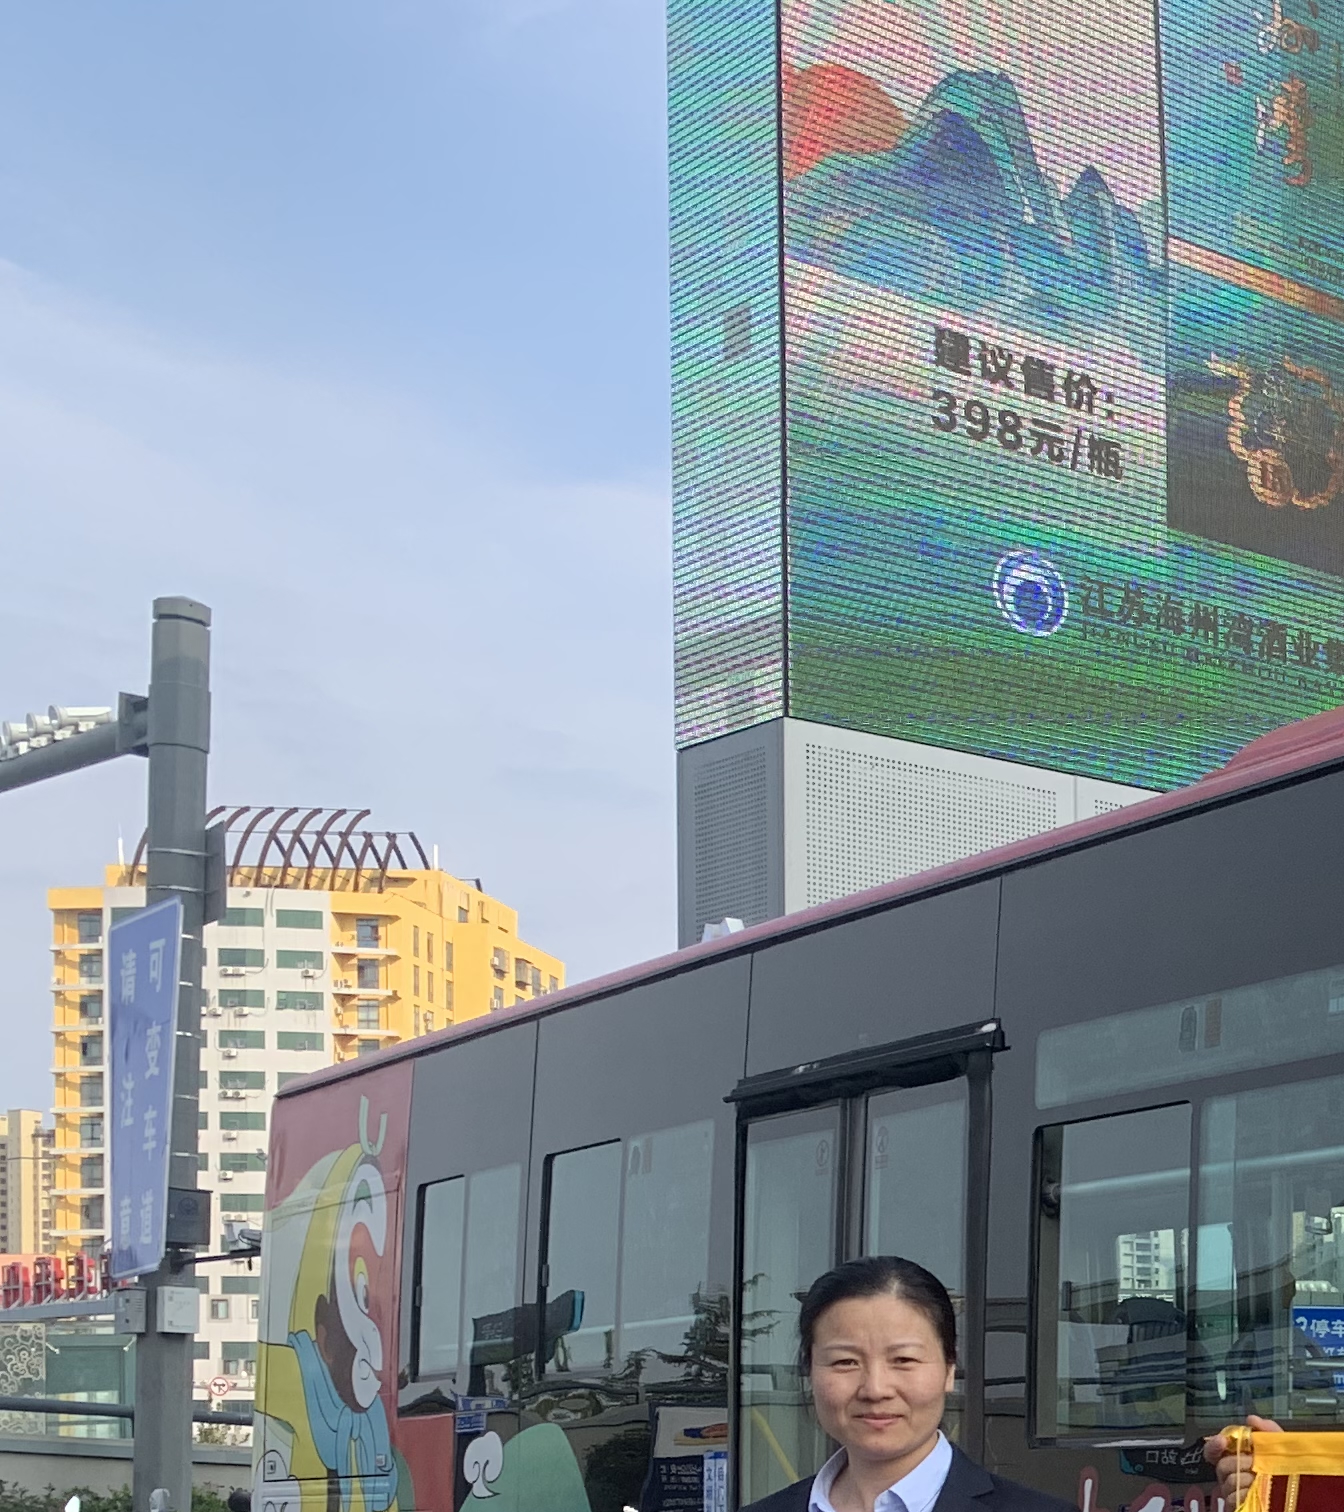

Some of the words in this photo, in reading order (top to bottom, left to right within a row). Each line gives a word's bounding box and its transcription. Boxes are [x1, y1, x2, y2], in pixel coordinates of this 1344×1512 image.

[932, 389, 1124, 480] 398元/瓶
[118, 947, 143, 1251] 请注意
[139, 937, 167, 1246] 可变车道
